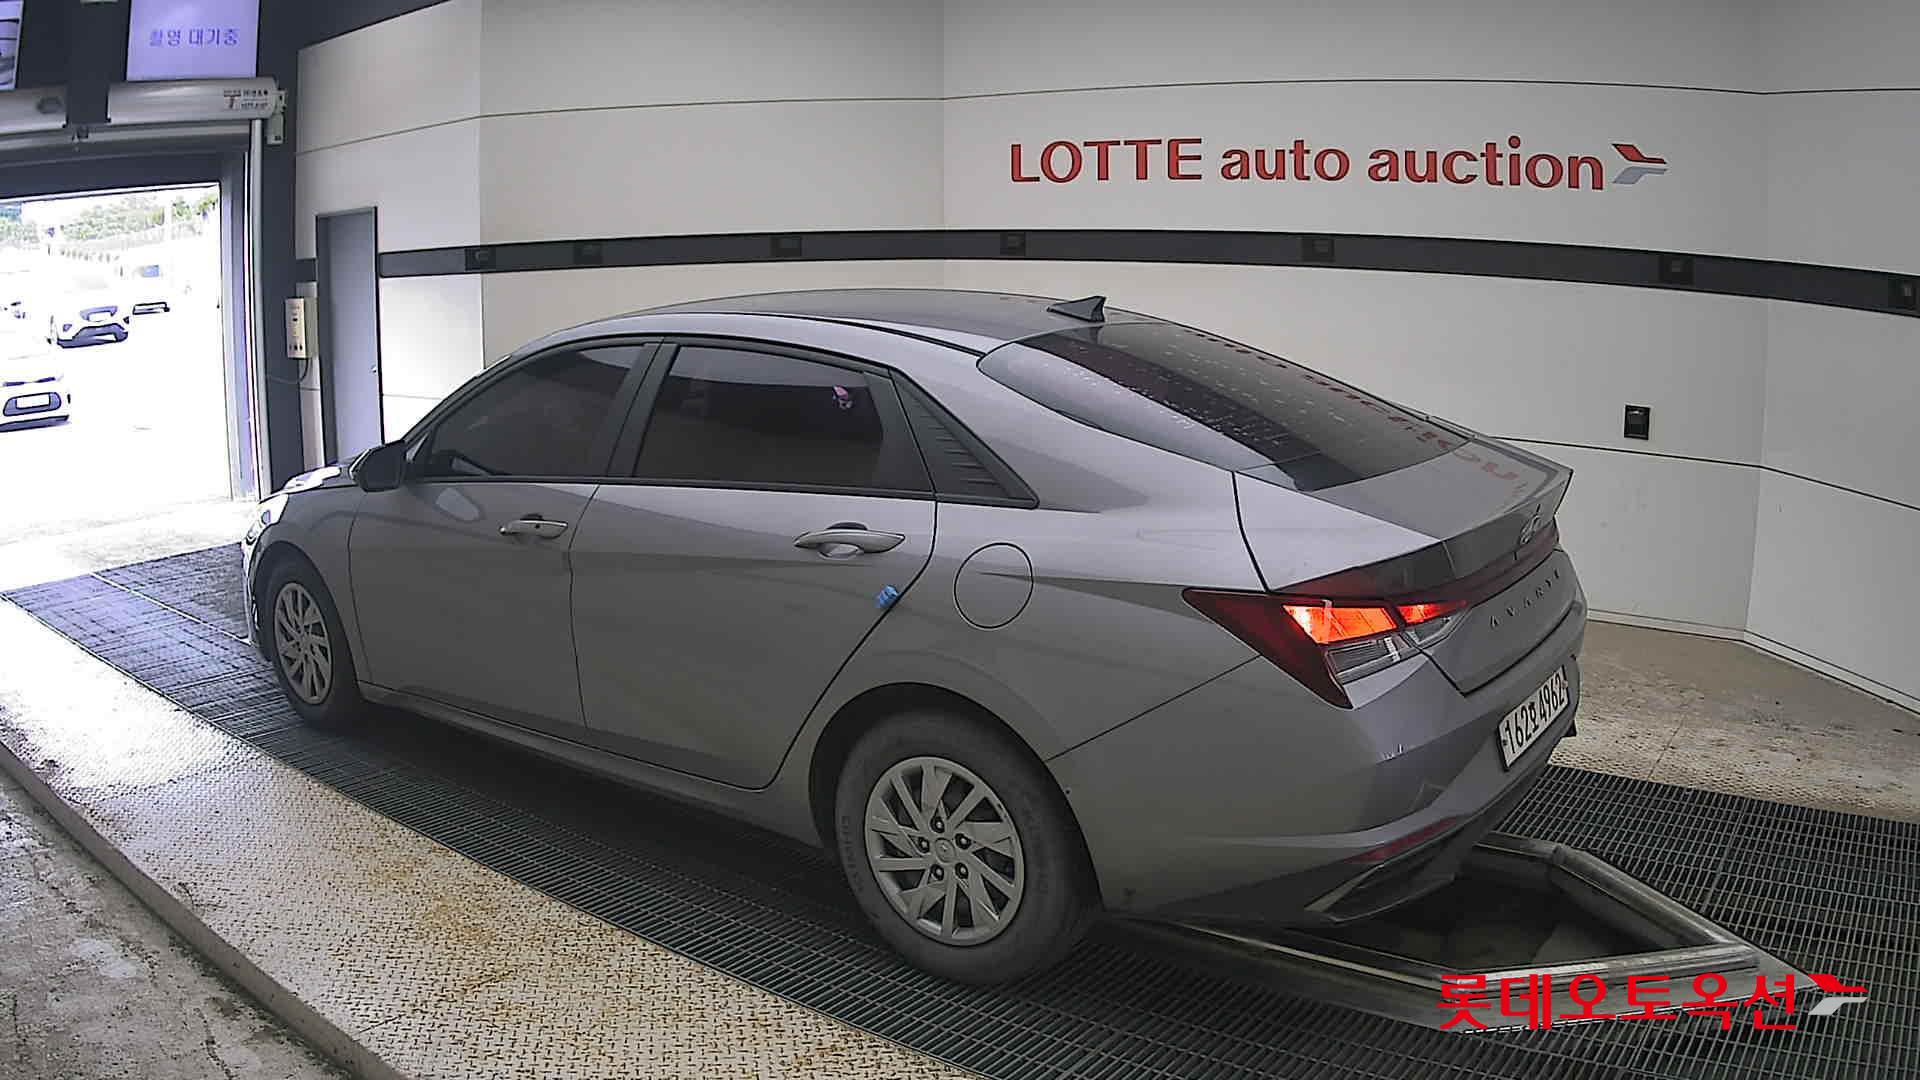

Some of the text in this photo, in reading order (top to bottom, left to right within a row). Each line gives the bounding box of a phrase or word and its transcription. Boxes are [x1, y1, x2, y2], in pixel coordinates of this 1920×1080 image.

[188, 27, 238, 47] 대기중
[1010, 135, 1604, 191] LOTTE auto auction
[1540, 672, 1565, 722] 4962
